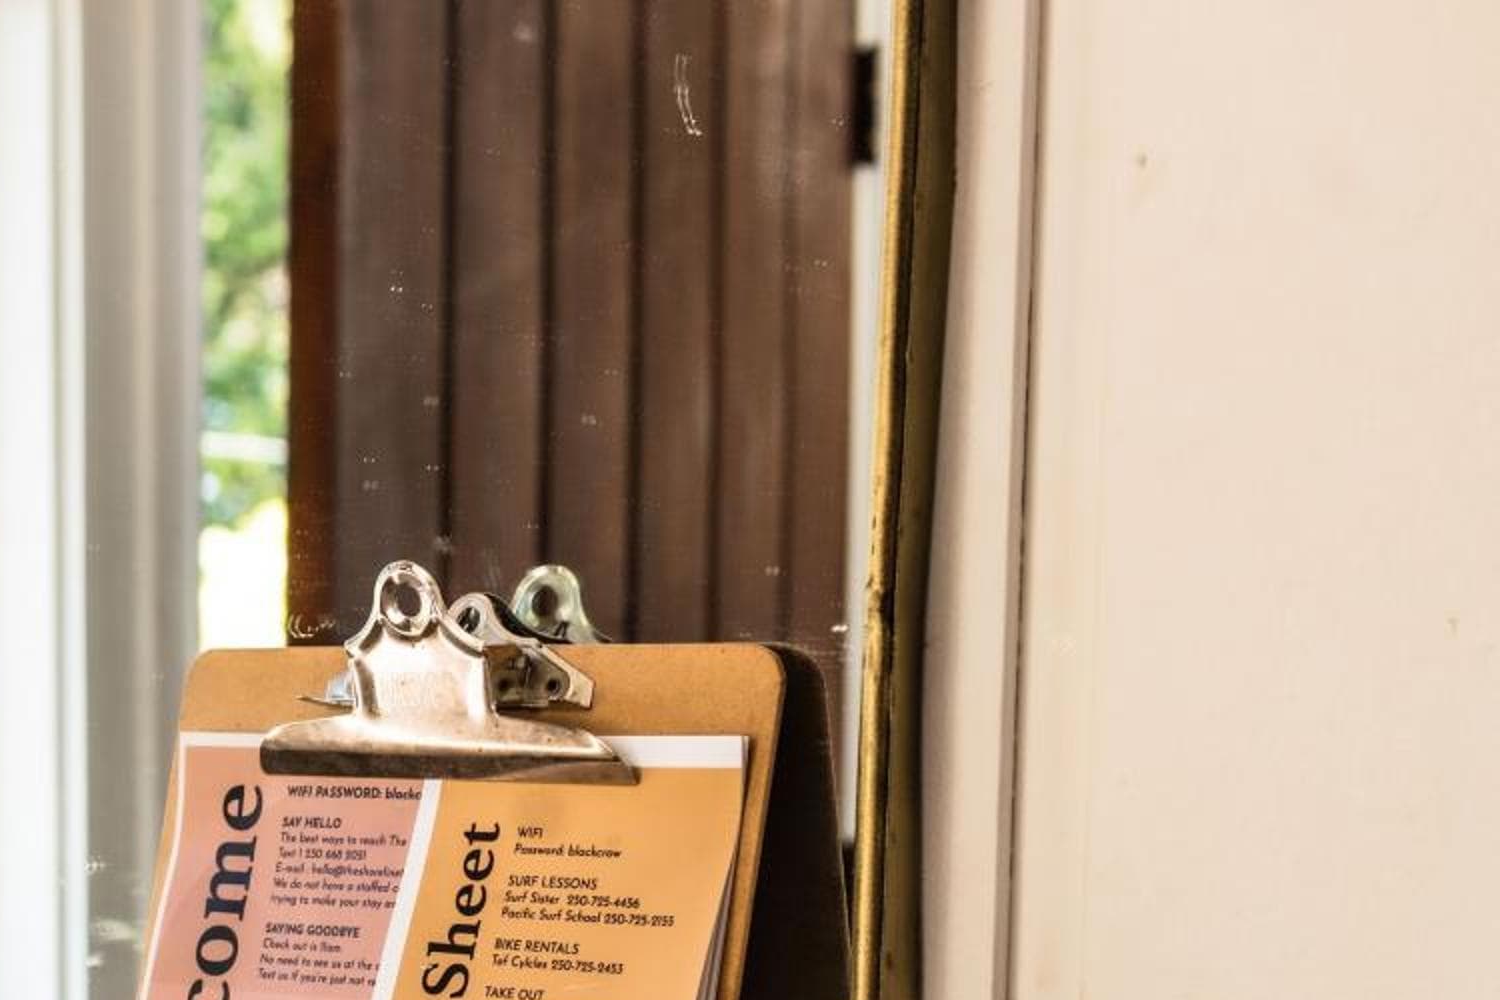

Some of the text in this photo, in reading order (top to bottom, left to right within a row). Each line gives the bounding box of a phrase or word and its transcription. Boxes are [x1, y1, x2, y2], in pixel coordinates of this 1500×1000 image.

[287, 785, 313, 797] WIFI
[282, 816, 342, 829] SAY HELLO
[281, 831, 408, 847] The best ways to reach The
[517, 826, 544, 839] WIFI
[567, 844, 622, 858] blackcrow
[273, 877, 287, 889] We
[289, 879, 302, 889] do
[304, 881, 320, 889] not
[508, 874, 597, 891] SURF LESSONS
[299, 896, 309, 905] to
[505, 890, 528, 903] Surf
[530, 891, 560, 905] Sister
[421, 822, 500, 999] Sheet
[501, 906, 536, 919] Pacific
[539, 908, 563, 921] Surf
[565, 909, 601, 923] School
[265, 922, 360, 939] SAYING GOODBYE
[494, 937, 580, 955] BIKE RENTALS
[277, 957, 299, 966] need
[301, 958, 311, 967] to
[313, 959, 329, 968] see
[343, 959, 355, 969] at
[357, 959, 373, 971] the
[485, 985, 545, 1000] TAKE OUT
